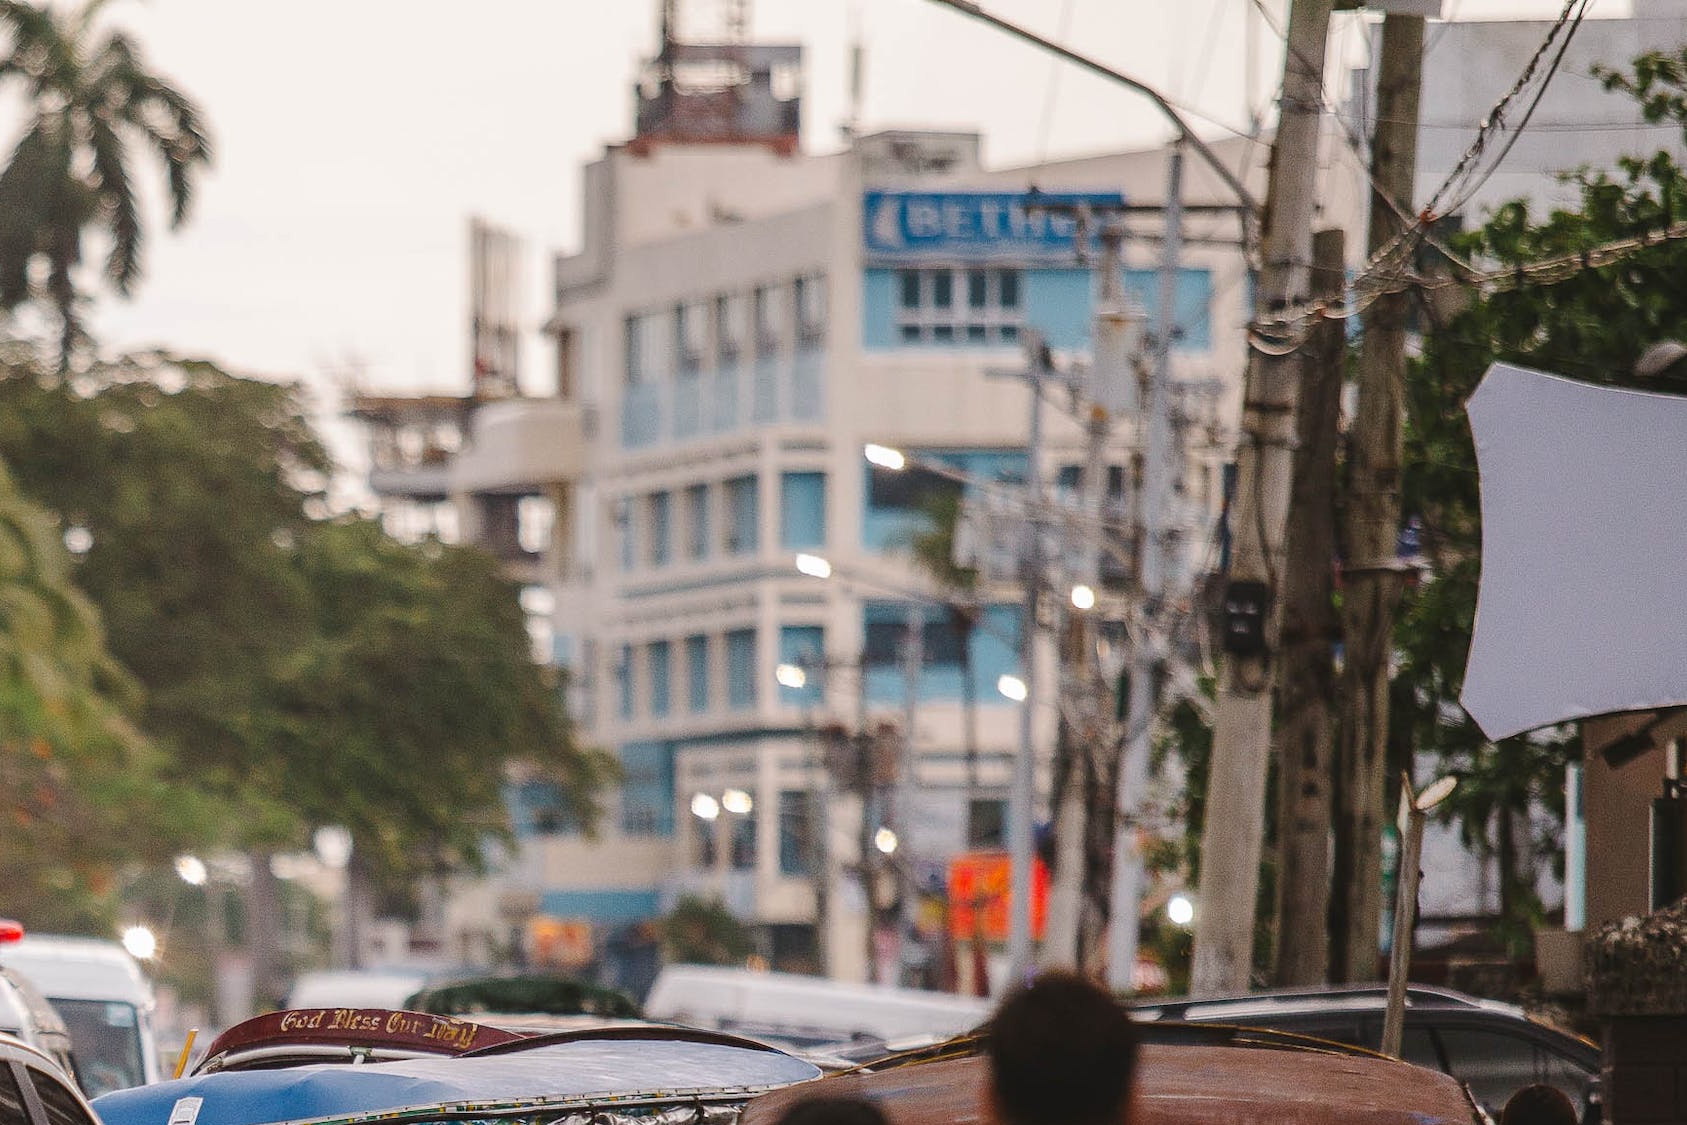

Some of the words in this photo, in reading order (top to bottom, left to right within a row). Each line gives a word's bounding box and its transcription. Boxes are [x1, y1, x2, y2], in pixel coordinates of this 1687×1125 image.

[908, 203, 1098, 238] BETH
[281, 1010, 326, 1031] God
[327, 1008, 382, 1031] Bless
[386, 1012, 424, 1034] Our
